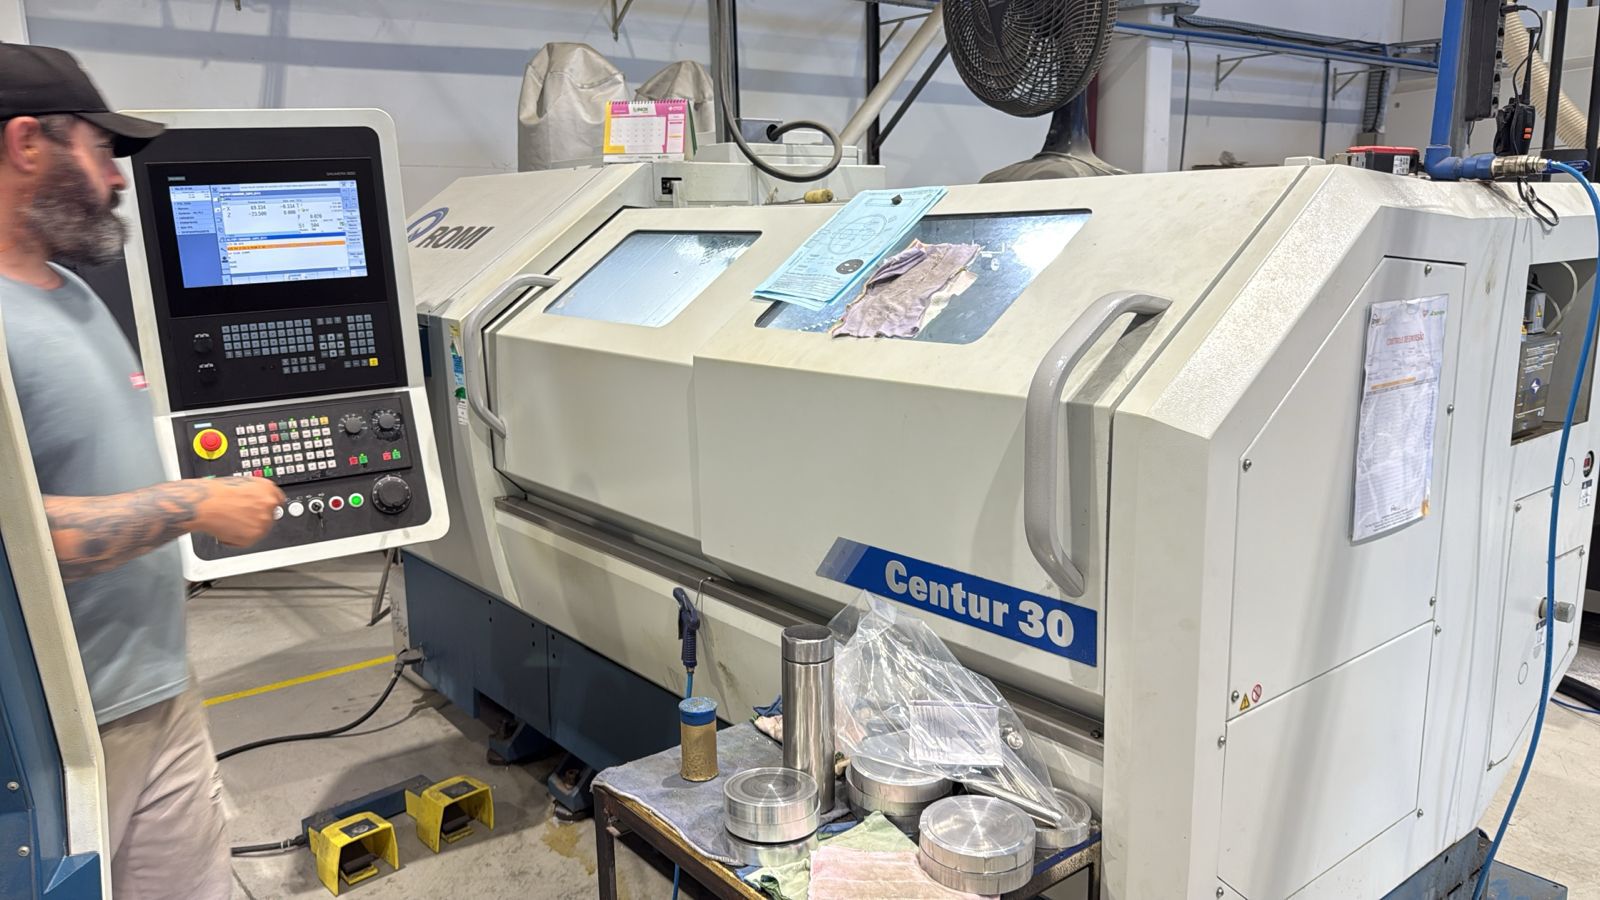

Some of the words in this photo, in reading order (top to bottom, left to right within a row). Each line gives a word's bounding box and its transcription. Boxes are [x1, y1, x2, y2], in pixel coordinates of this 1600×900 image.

[415, 226, 495, 250] ROMI
[885, 560, 1009, 628] Centur
[1018, 600, 1075, 648] 30
